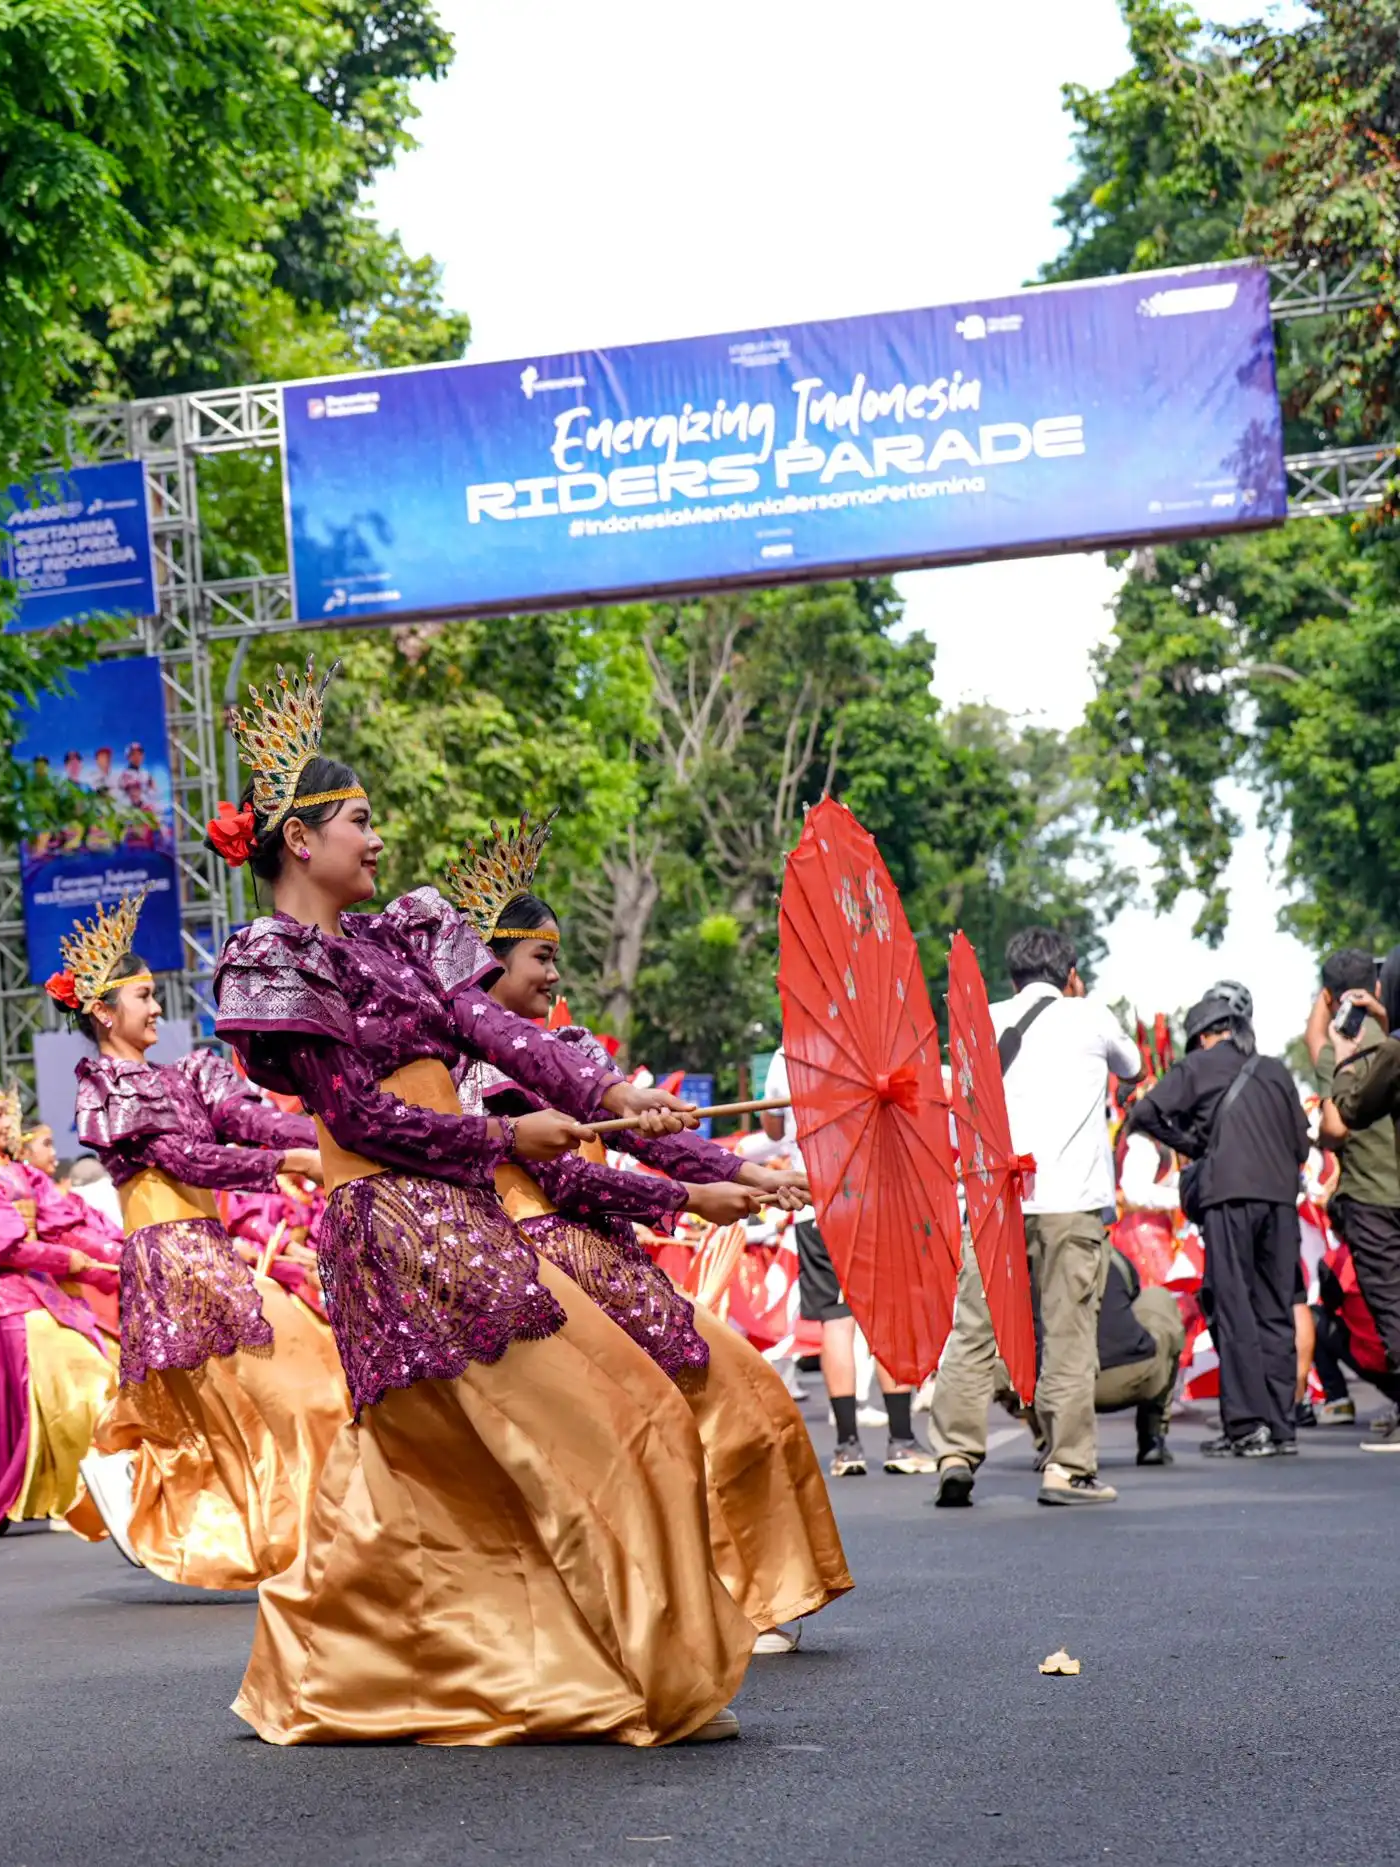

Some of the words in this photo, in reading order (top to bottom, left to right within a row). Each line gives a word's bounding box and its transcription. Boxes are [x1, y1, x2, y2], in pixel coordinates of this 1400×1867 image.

[551, 398, 775, 472] Energizing
[792, 370, 981, 450] Indonesia
[466, 453, 760, 524] RIDERS
[774, 415, 1085, 488] PARADE
[569, 474, 986, 538] #IndonesiaMenduniaBersamaPertamina
[16, 559, 41, 577] OF
[42, 546, 137, 573] INDONESIA
